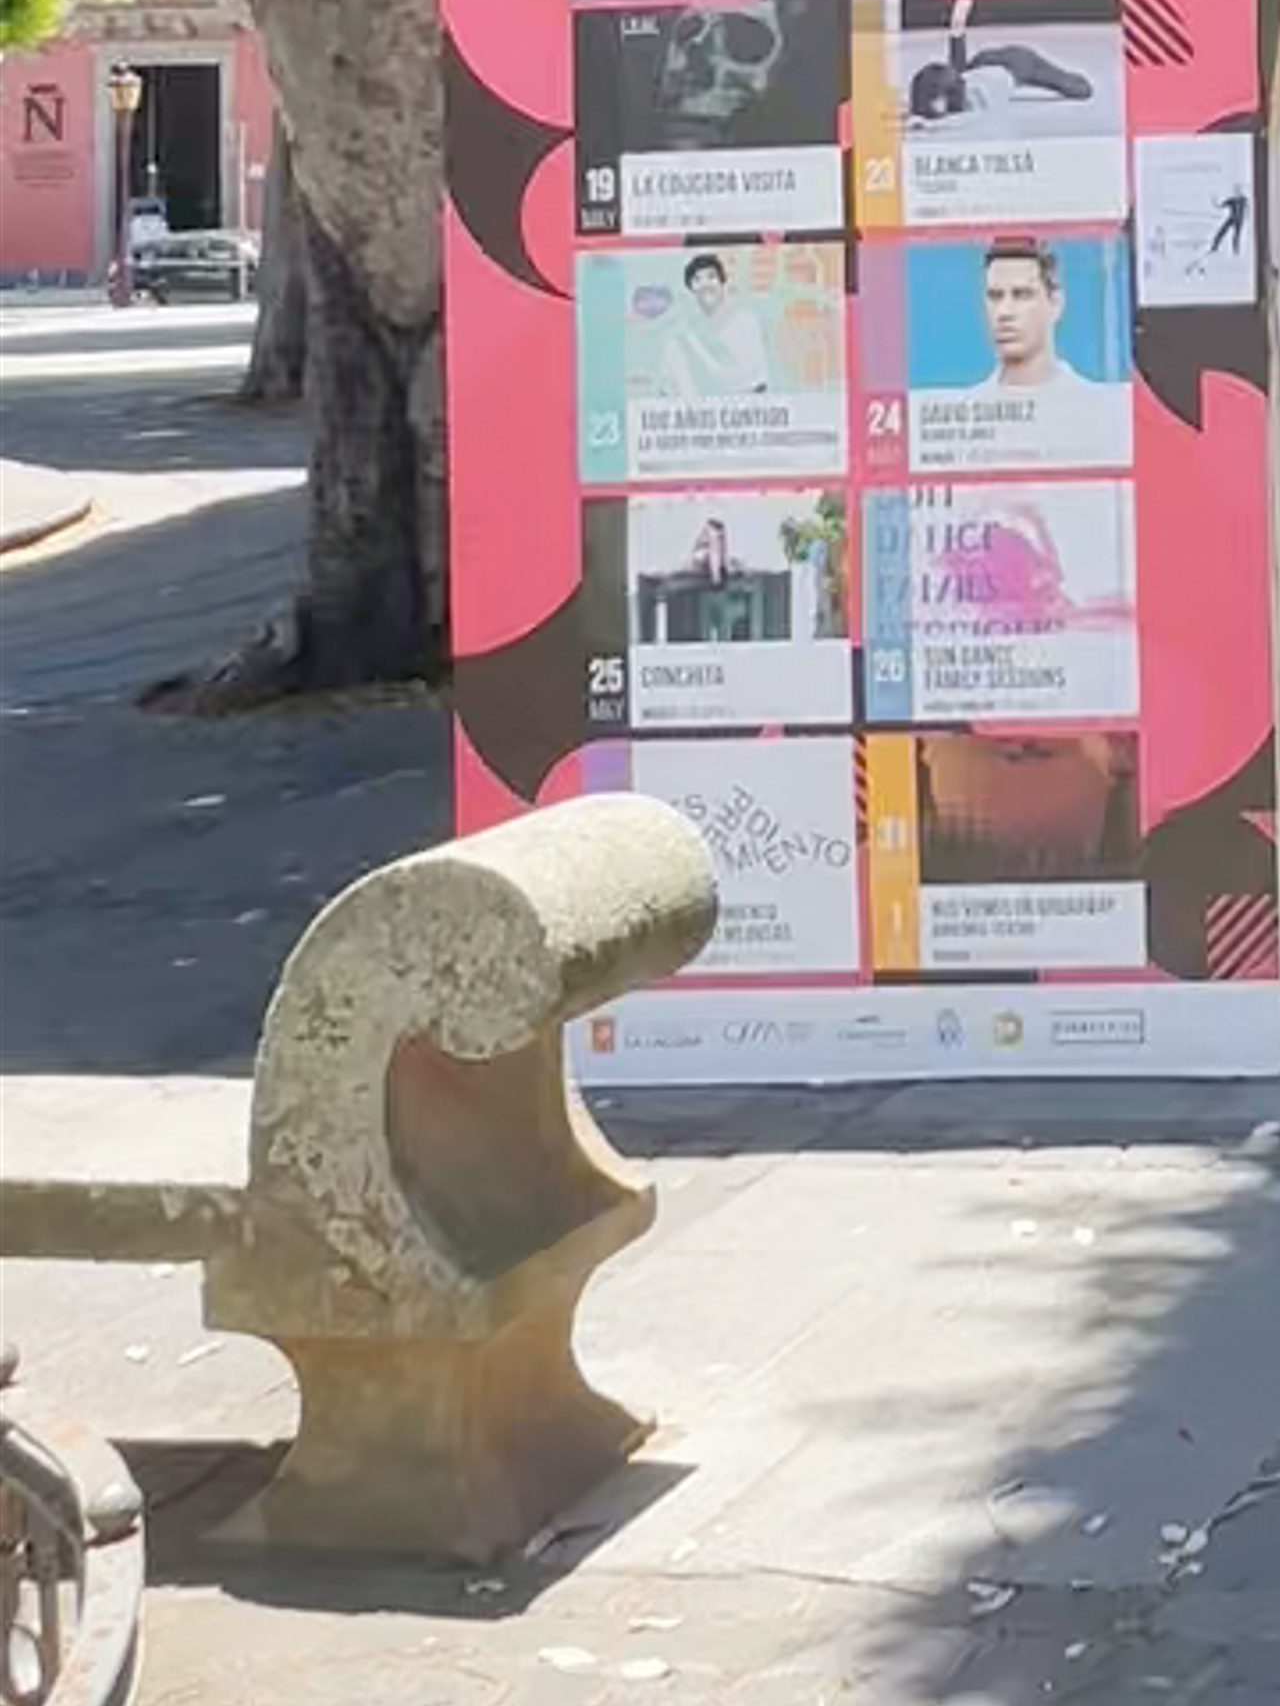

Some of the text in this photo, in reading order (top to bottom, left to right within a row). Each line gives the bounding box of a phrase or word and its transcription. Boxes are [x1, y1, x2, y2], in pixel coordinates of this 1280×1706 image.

[585, 166, 616, 202] 19
[867, 398, 901, 435] 24
[588, 658, 624, 694] 25
[641, 665, 724, 689] CONCHITA
